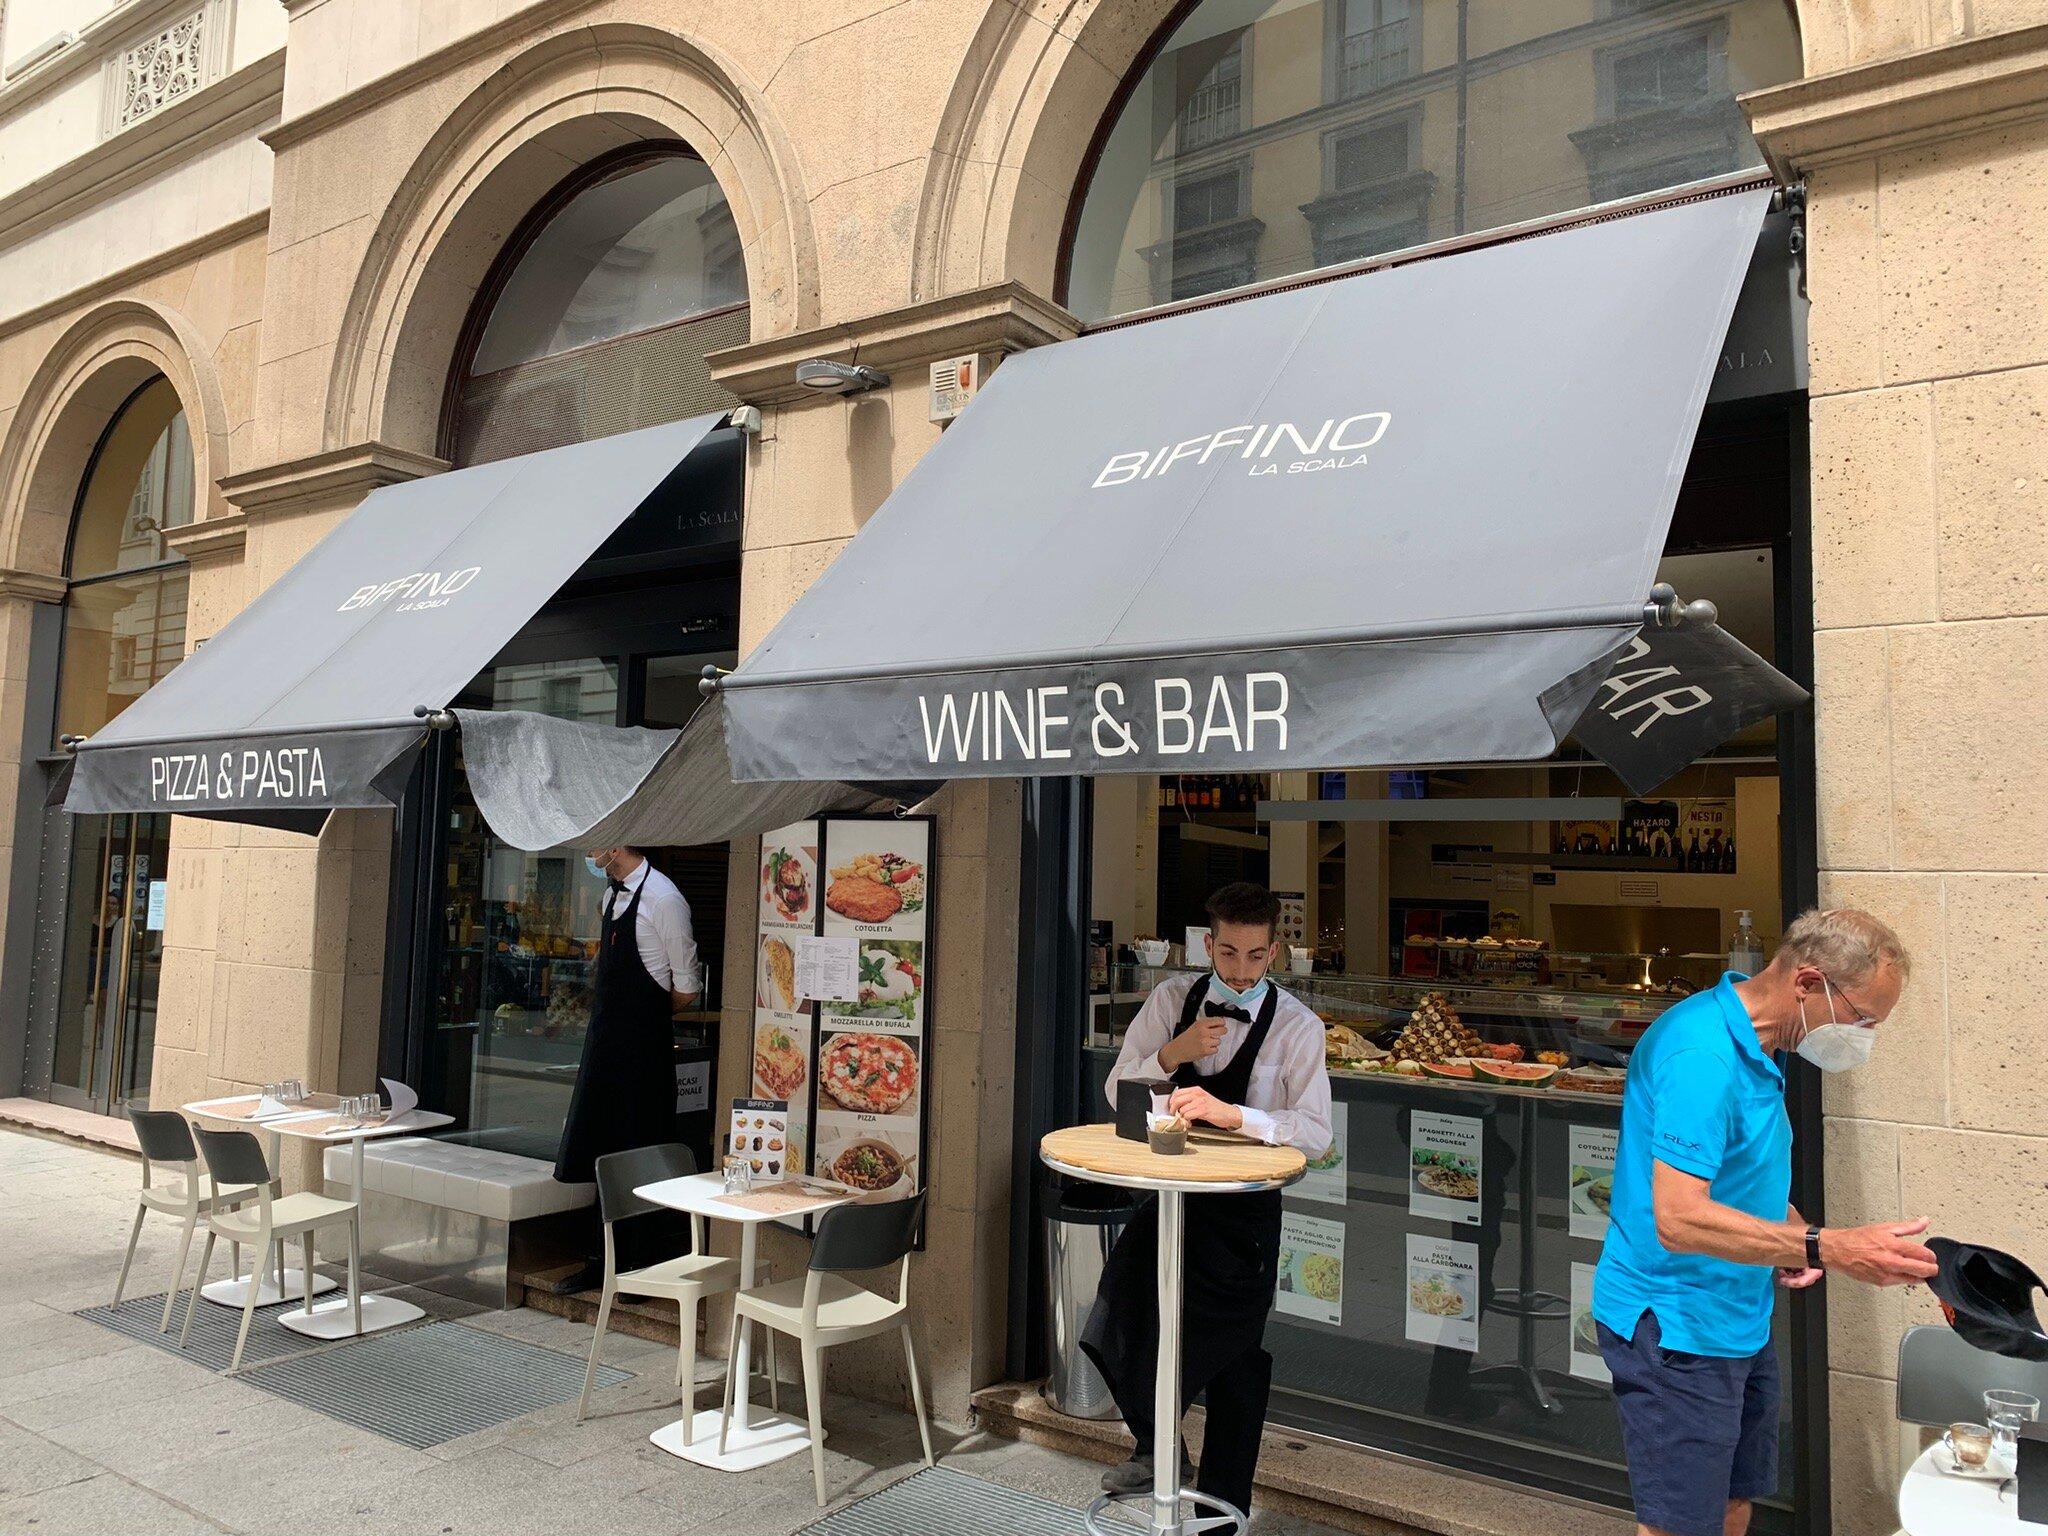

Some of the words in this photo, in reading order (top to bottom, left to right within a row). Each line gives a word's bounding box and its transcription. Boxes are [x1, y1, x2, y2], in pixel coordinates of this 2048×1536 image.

[1719, 349, 1773, 372] ALA
[1091, 411, 1393, 489] BIFFINO
[1247, 463, 1279, 477] LA
[1285, 453, 1370, 475] SCALA
[336, 566, 482, 612] BIFFINO
[395, 601, 412, 613] LA
[414, 597, 450, 611] SCALA
[918, 685, 1072, 764] WINE
[1090, 681, 1140, 757] &
[1153, 671, 1290, 755] BAR
[151, 753, 209, 802] PIZZA
[216, 751, 234, 800] &
[239, 747, 328, 799] PASTA
[1632, 817, 1671, 828] HAZARD
[1690, 810, 1723, 823] NESTA
[854, 925, 893, 933] COTOLETTA
[830, 1017, 874, 1027] MOZZARELLA
[884, 1020, 911, 1029] BUFALA
[747, 1100, 775, 1109] BIFFINO
[857, 1114, 877, 1122] PIZZA
[1418, 1127, 1456, 1137] SPAGHETTI
[1457, 1132, 1475, 1140] ALLA
[1425, 1136, 1467, 1147] BOLOGNESE
[1577, 1143, 1617, 1153] COTOLETT
[1664, 1133, 1702, 1152] RLX
[1591, 1153, 1615, 1162] MILAN
[1283, 1227, 1303, 1235] PASTA
[1325, 1235, 1342, 1243] OLIO
[1293, 1236, 1337, 1250] PEPERONCINO
[1412, 1255, 1430, 1264] ALLA
[1431, 1258, 1473, 1271] CARBONARA
[1432, 1252, 1453, 1261] PASTA
